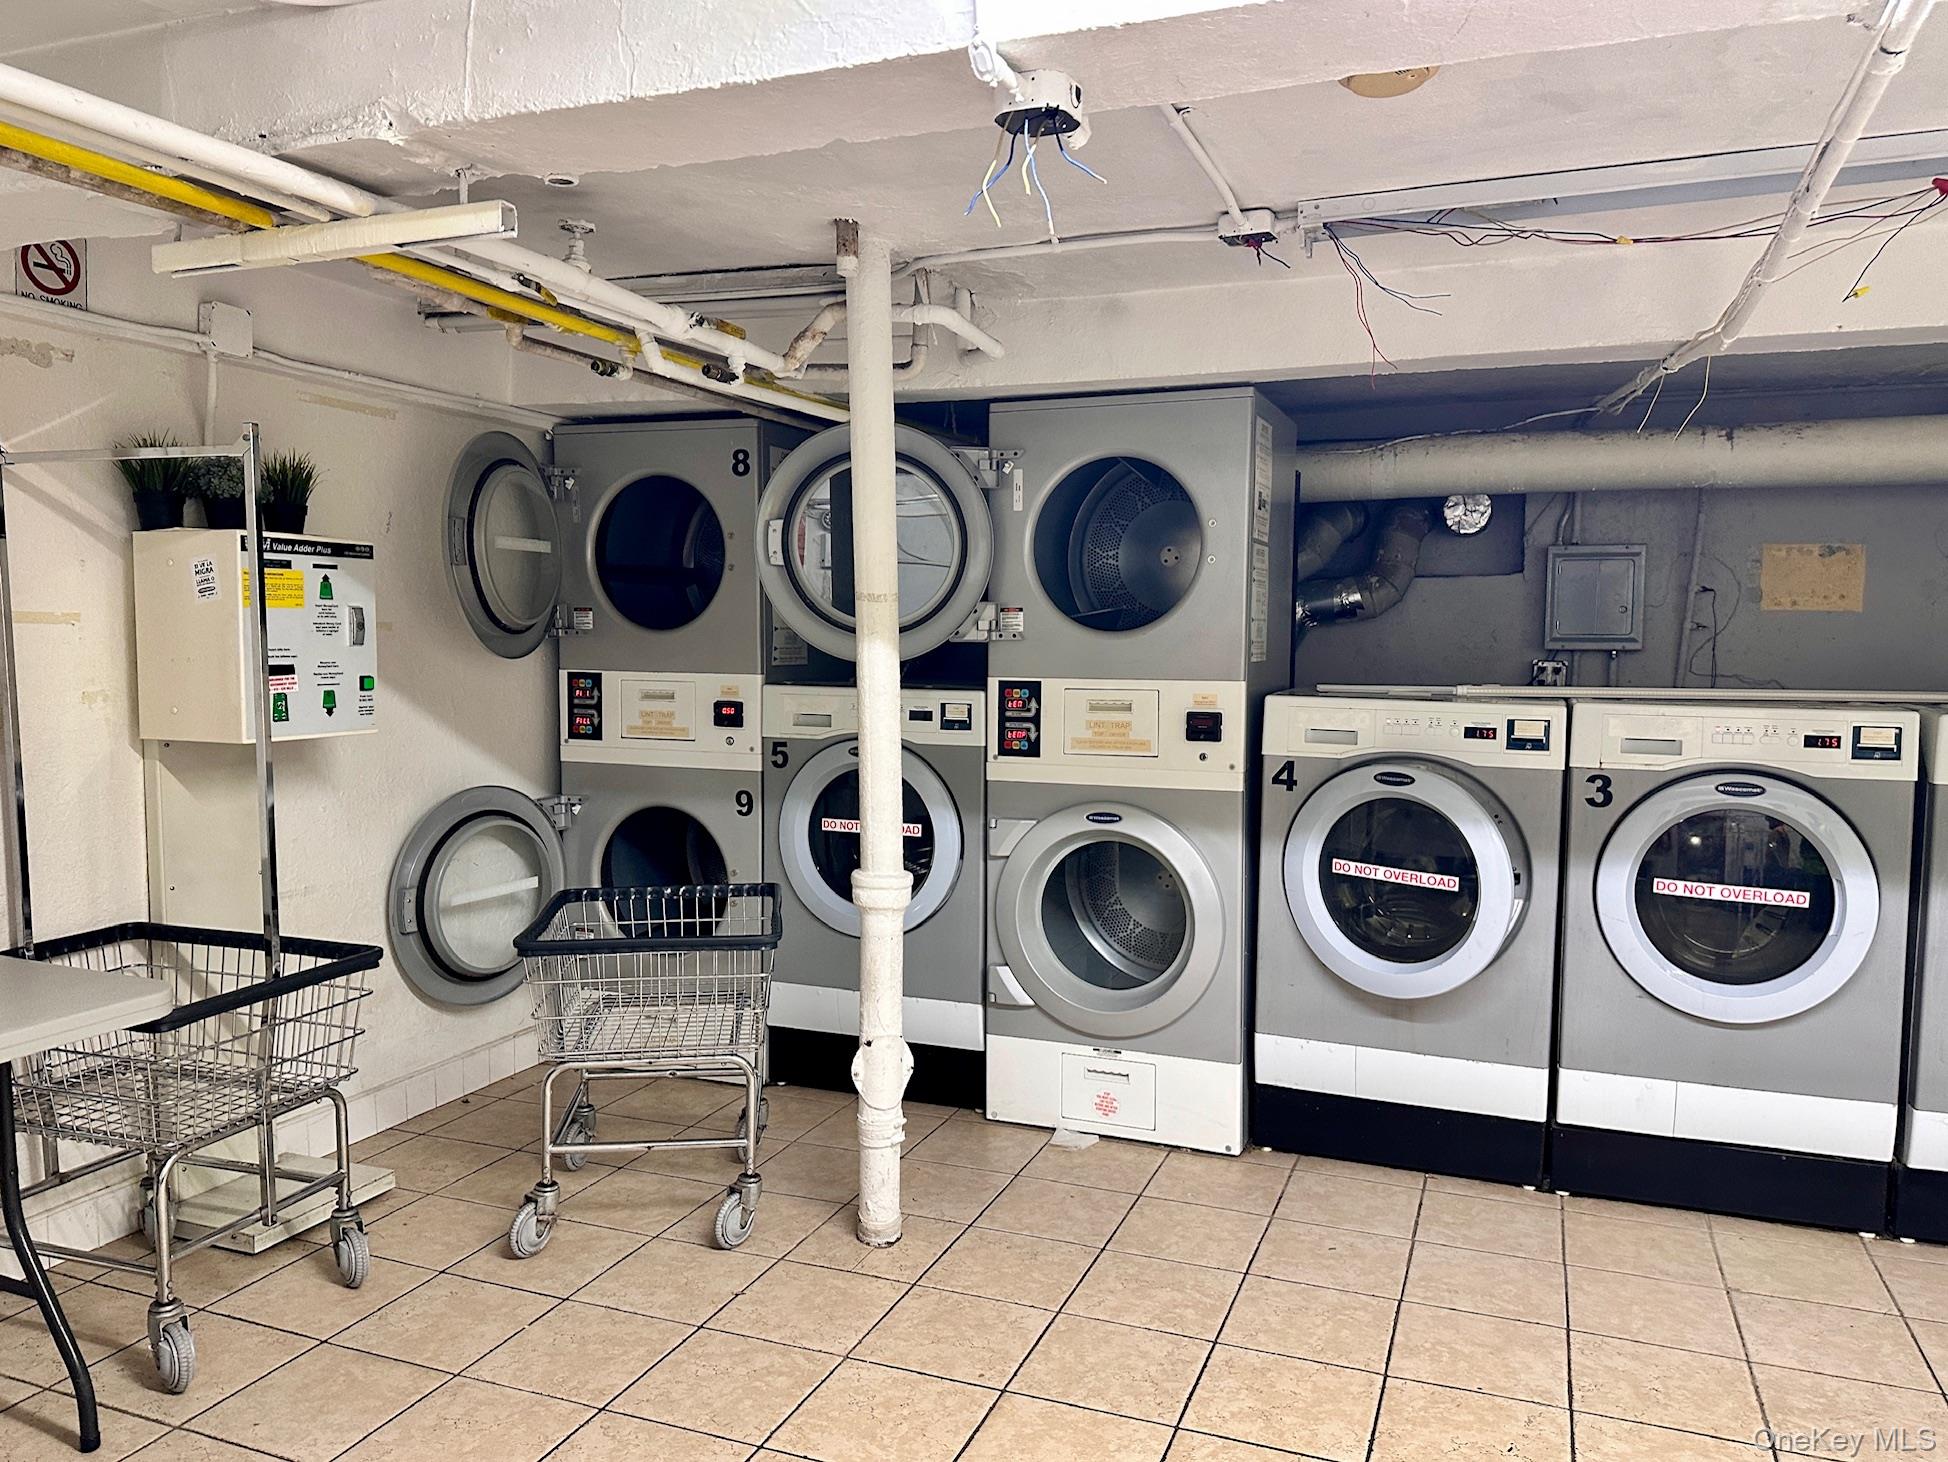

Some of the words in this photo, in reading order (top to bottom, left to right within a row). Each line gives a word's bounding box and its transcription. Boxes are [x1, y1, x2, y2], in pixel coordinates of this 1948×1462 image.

[732, 449, 750, 477] 8
[272, 542, 292, 552] Value
[293, 544, 315, 554] Adder
[316, 545, 332, 554] Plus
[770, 741, 789, 768] 5
[1271, 760, 1298, 792] 4
[735, 790, 754, 816] 9
[1585, 774, 1613, 808] 3
[823, 820, 837, 829] DO
[840, 821, 860, 831] NOT
[1334, 861, 1351, 873] DO
[1354, 865, 1380, 877] NOT
[1383, 869, 1457, 889] OVERLOAD
[1656, 880, 1678, 892] DO
[1683, 884, 1716, 897] NOT
[1720, 887, 1808, 906] OVERLOAD
